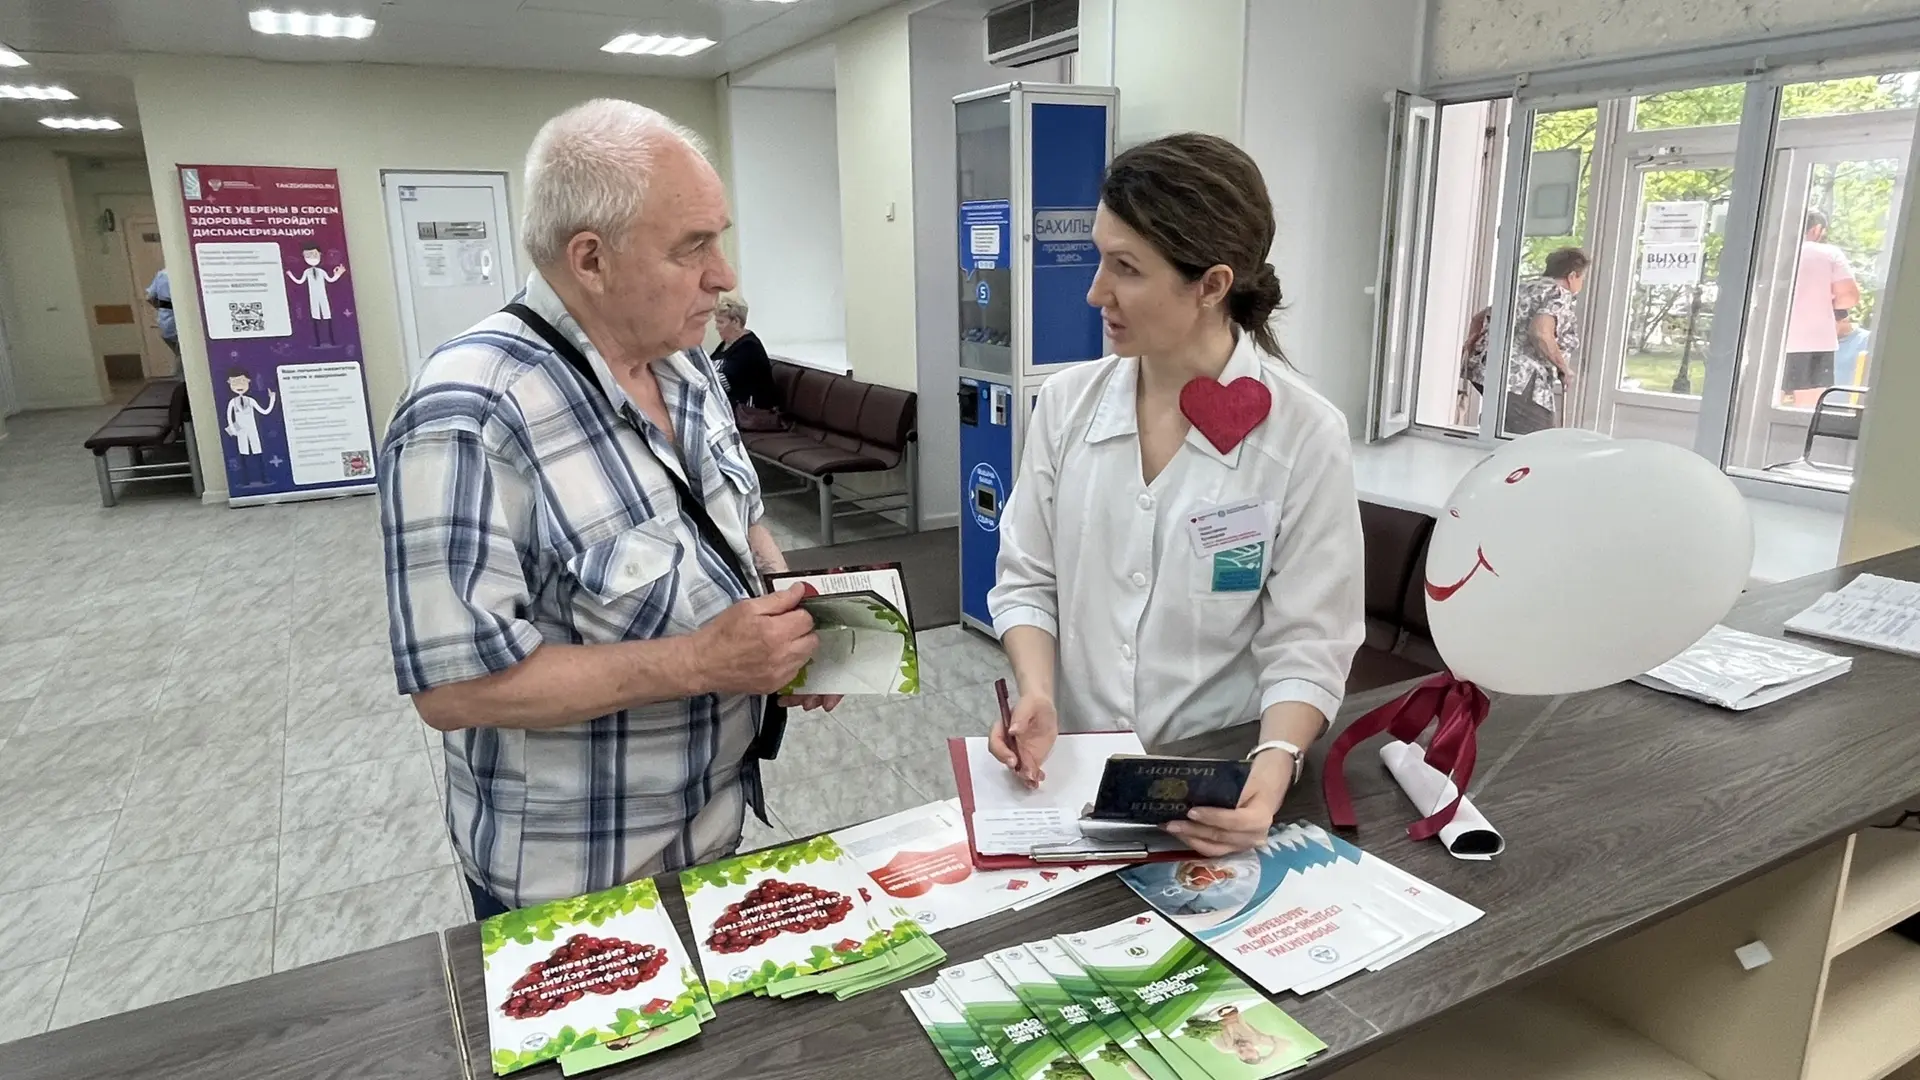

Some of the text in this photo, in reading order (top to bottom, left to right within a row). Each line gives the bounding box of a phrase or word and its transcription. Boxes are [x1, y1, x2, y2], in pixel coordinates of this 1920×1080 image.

[189, 205, 339, 214] БУДЬТЕ УВЕРЕНЫ В СВОЕМ
[191, 217, 253, 225] ЗДОРОВЬЕ
[267, 216, 328, 225] ПРОЙДИТЕ
[1036, 219, 1094, 234] БАХИЛЫ
[193, 228, 315, 237] ДИСПАНСЕРИЗАЦИЮ!
[1646, 252, 1697, 264] ВЫХОД
[1135, 766, 1216, 776] ПАСПОРТ
[1130, 802, 1188, 812] ОССИЯ
[740, 910, 828, 937] Профилактика
[1264, 921, 1340, 957] ПРОФИЛАКТИКА
[540, 966, 639, 1000] Профилактика
